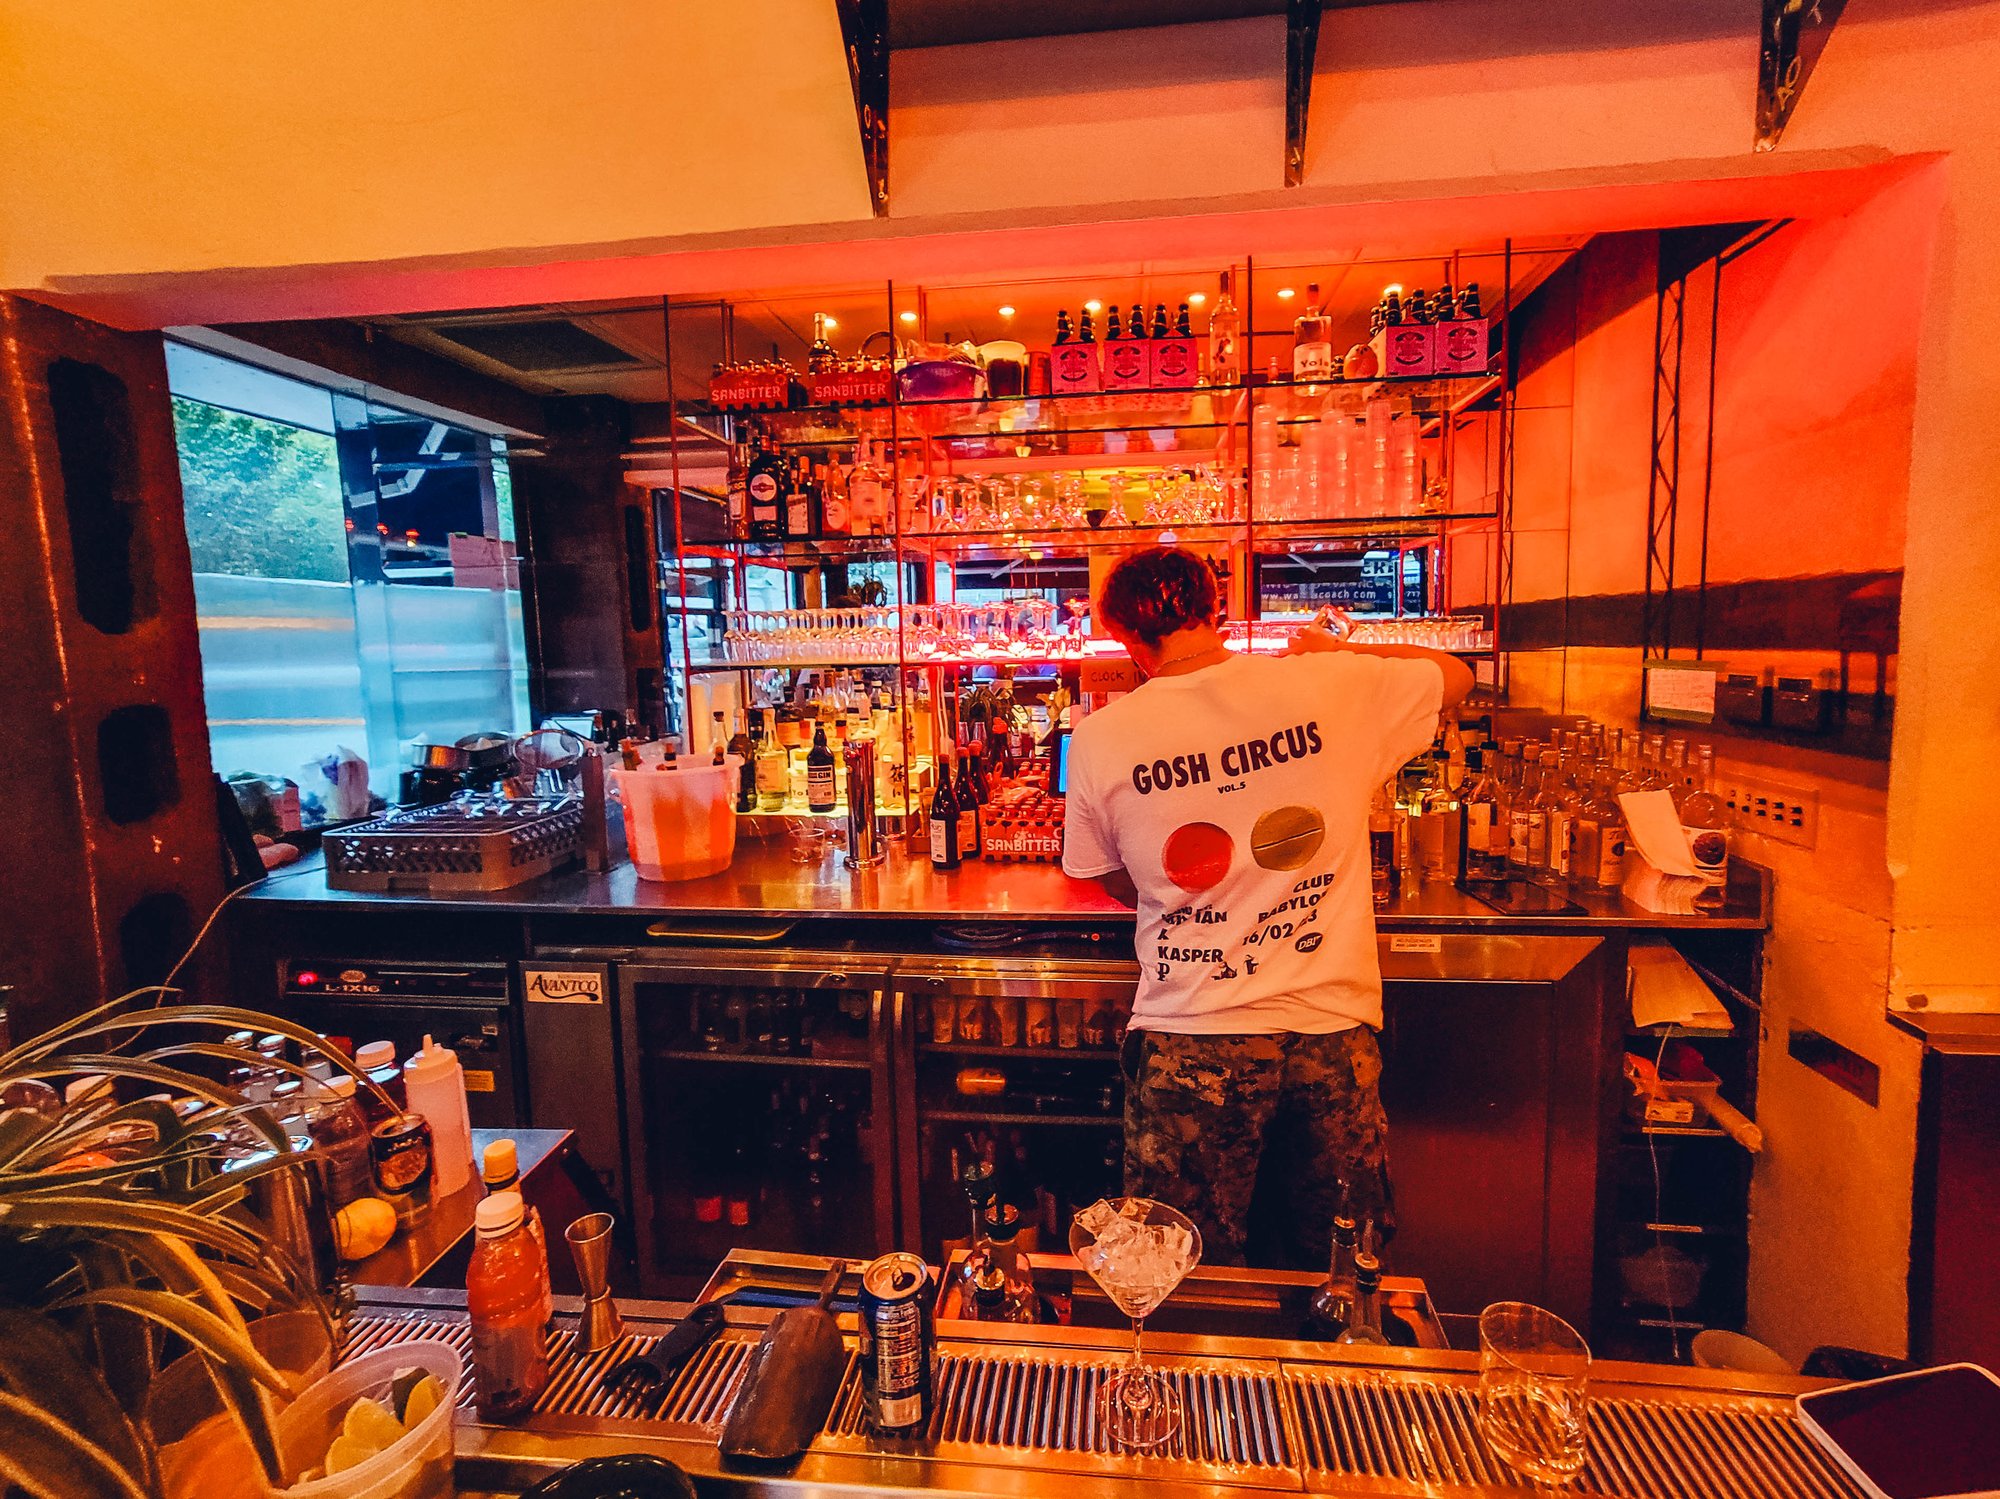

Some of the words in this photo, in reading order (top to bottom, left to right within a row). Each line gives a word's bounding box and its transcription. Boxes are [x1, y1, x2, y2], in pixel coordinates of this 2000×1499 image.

[711, 386, 781, 402] SANBITTER
[814, 383, 886, 399] SANBITTER
[1091, 670, 1125, 682] CLOCK
[1133, 752, 1211, 795] GOSH
[1221, 721, 1322, 777] CIRCUS
[1217, 782, 1246, 794] VOL.5
[986, 839, 1061, 852] SANBITTER
[1292, 873, 1335, 893] CLUB
[1258, 890, 1328, 924] BABYLO
[1157, 946, 1224, 963] KASPER
[530, 974, 599, 998] AVANTCO
